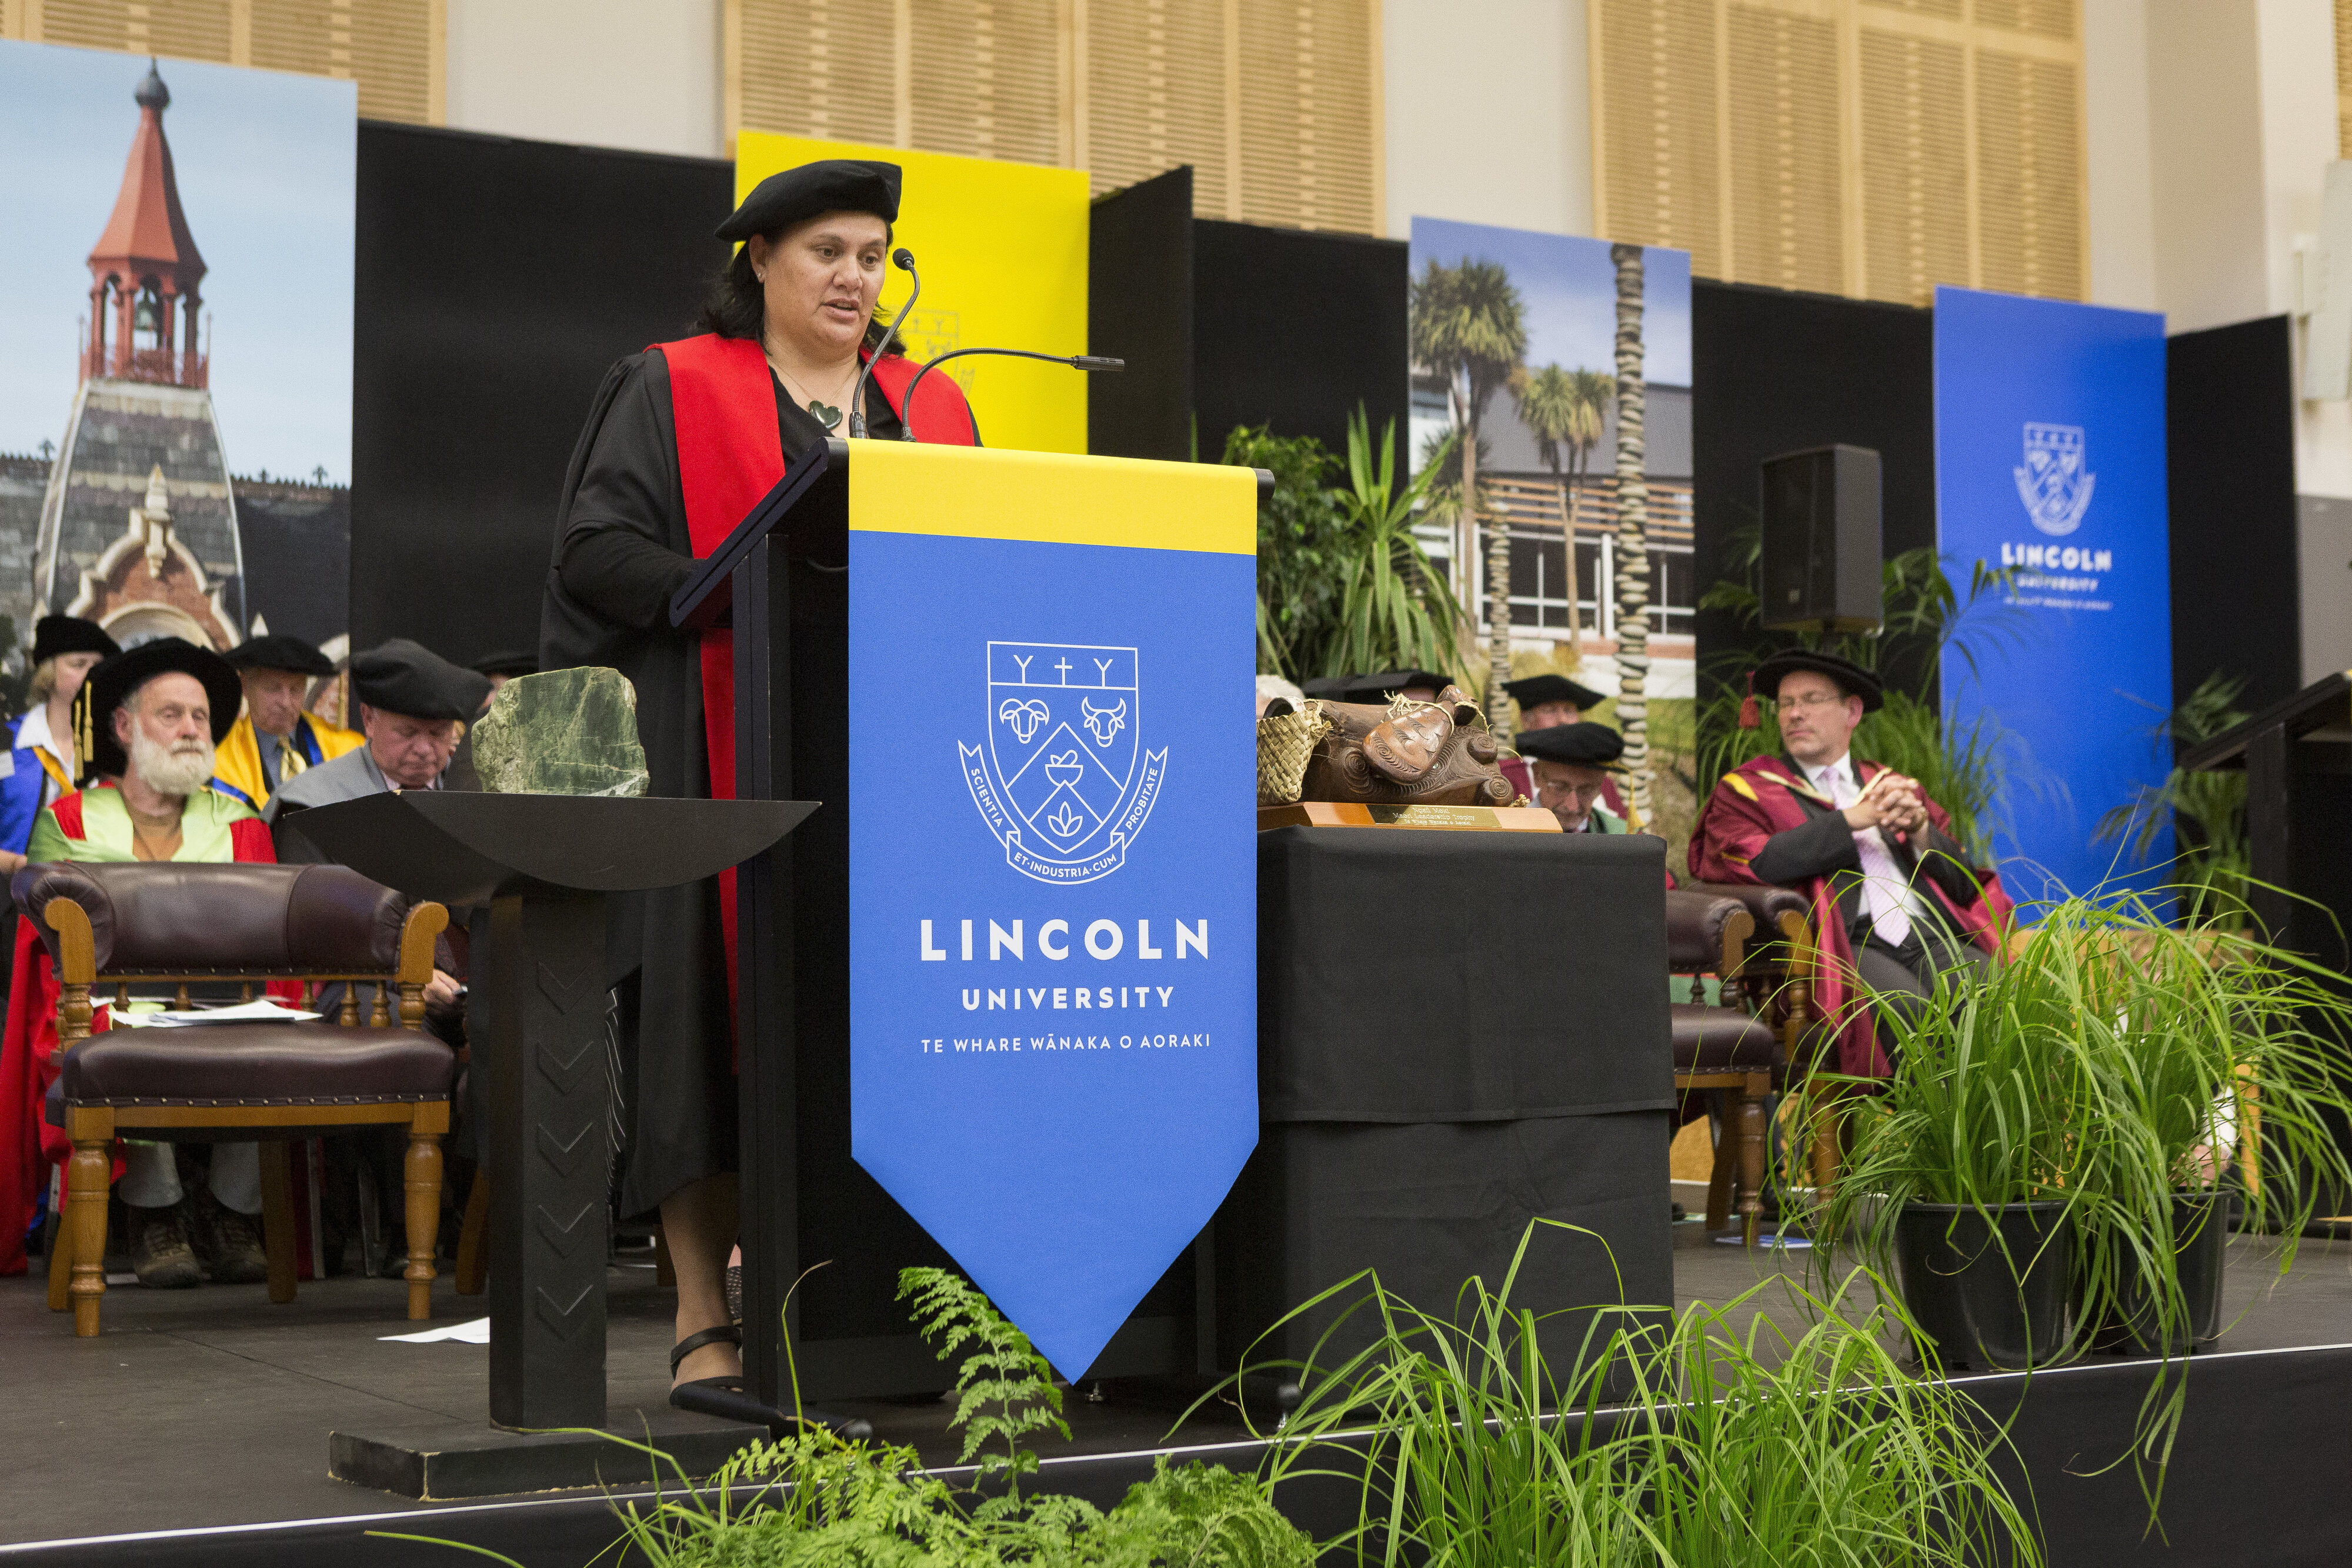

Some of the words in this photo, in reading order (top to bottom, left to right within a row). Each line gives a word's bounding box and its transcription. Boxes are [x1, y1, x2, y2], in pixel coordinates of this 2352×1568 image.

[2001, 542, 2112, 572] LINCOLN
[971, 768, 1003, 828] SCIENTIA
[1125, 768, 1158, 830] PROBITATE
[920, 918, 1209, 962] LINCOLN
[962, 986, 1174, 1011] UNIVERSITY
[921, 1039, 943, 1053] TE
[953, 1037, 1022, 1052] WHARE
[1030, 1033, 1112, 1050] WĀNAKA
[1119, 1035, 1132, 1049] O
[1140, 1033, 1210, 1049] AORAKI
